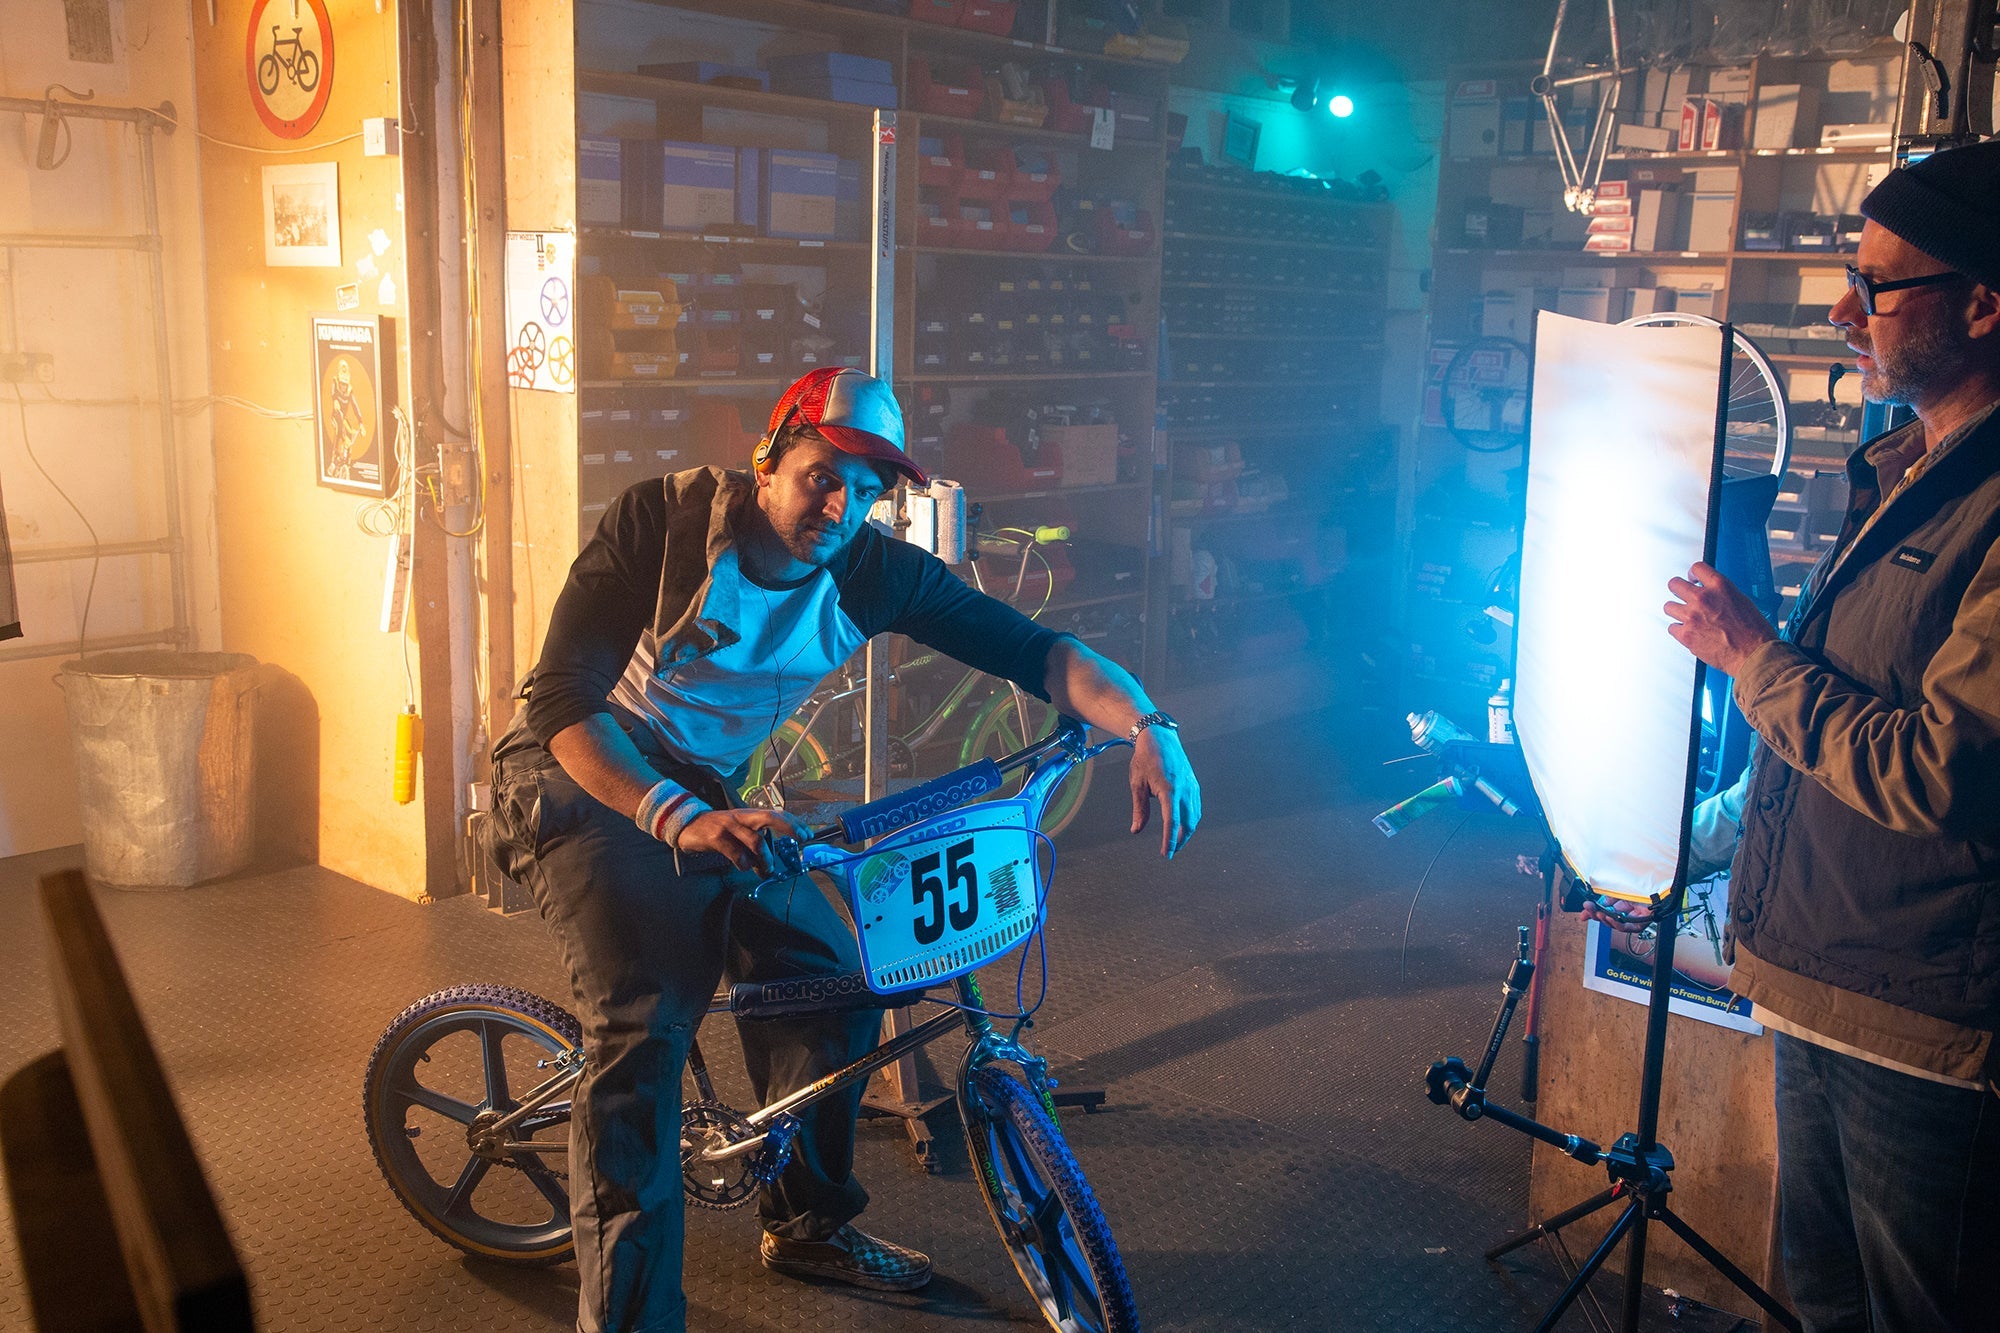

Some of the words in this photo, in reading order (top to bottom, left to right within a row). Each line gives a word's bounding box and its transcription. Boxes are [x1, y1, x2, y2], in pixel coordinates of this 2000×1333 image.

[317, 325, 373, 343] KUWAHARA
[862, 776, 987, 838] mongoose
[909, 817, 966, 842] HARO
[910, 838, 979, 945] 55
[1606, 968, 1619, 978] Go
[1619, 972, 1632, 981] for
[1632, 975, 1639, 983] it
[1679, 989, 1706, 1002] Frame
[1706, 996, 1740, 1011] Burnrs
